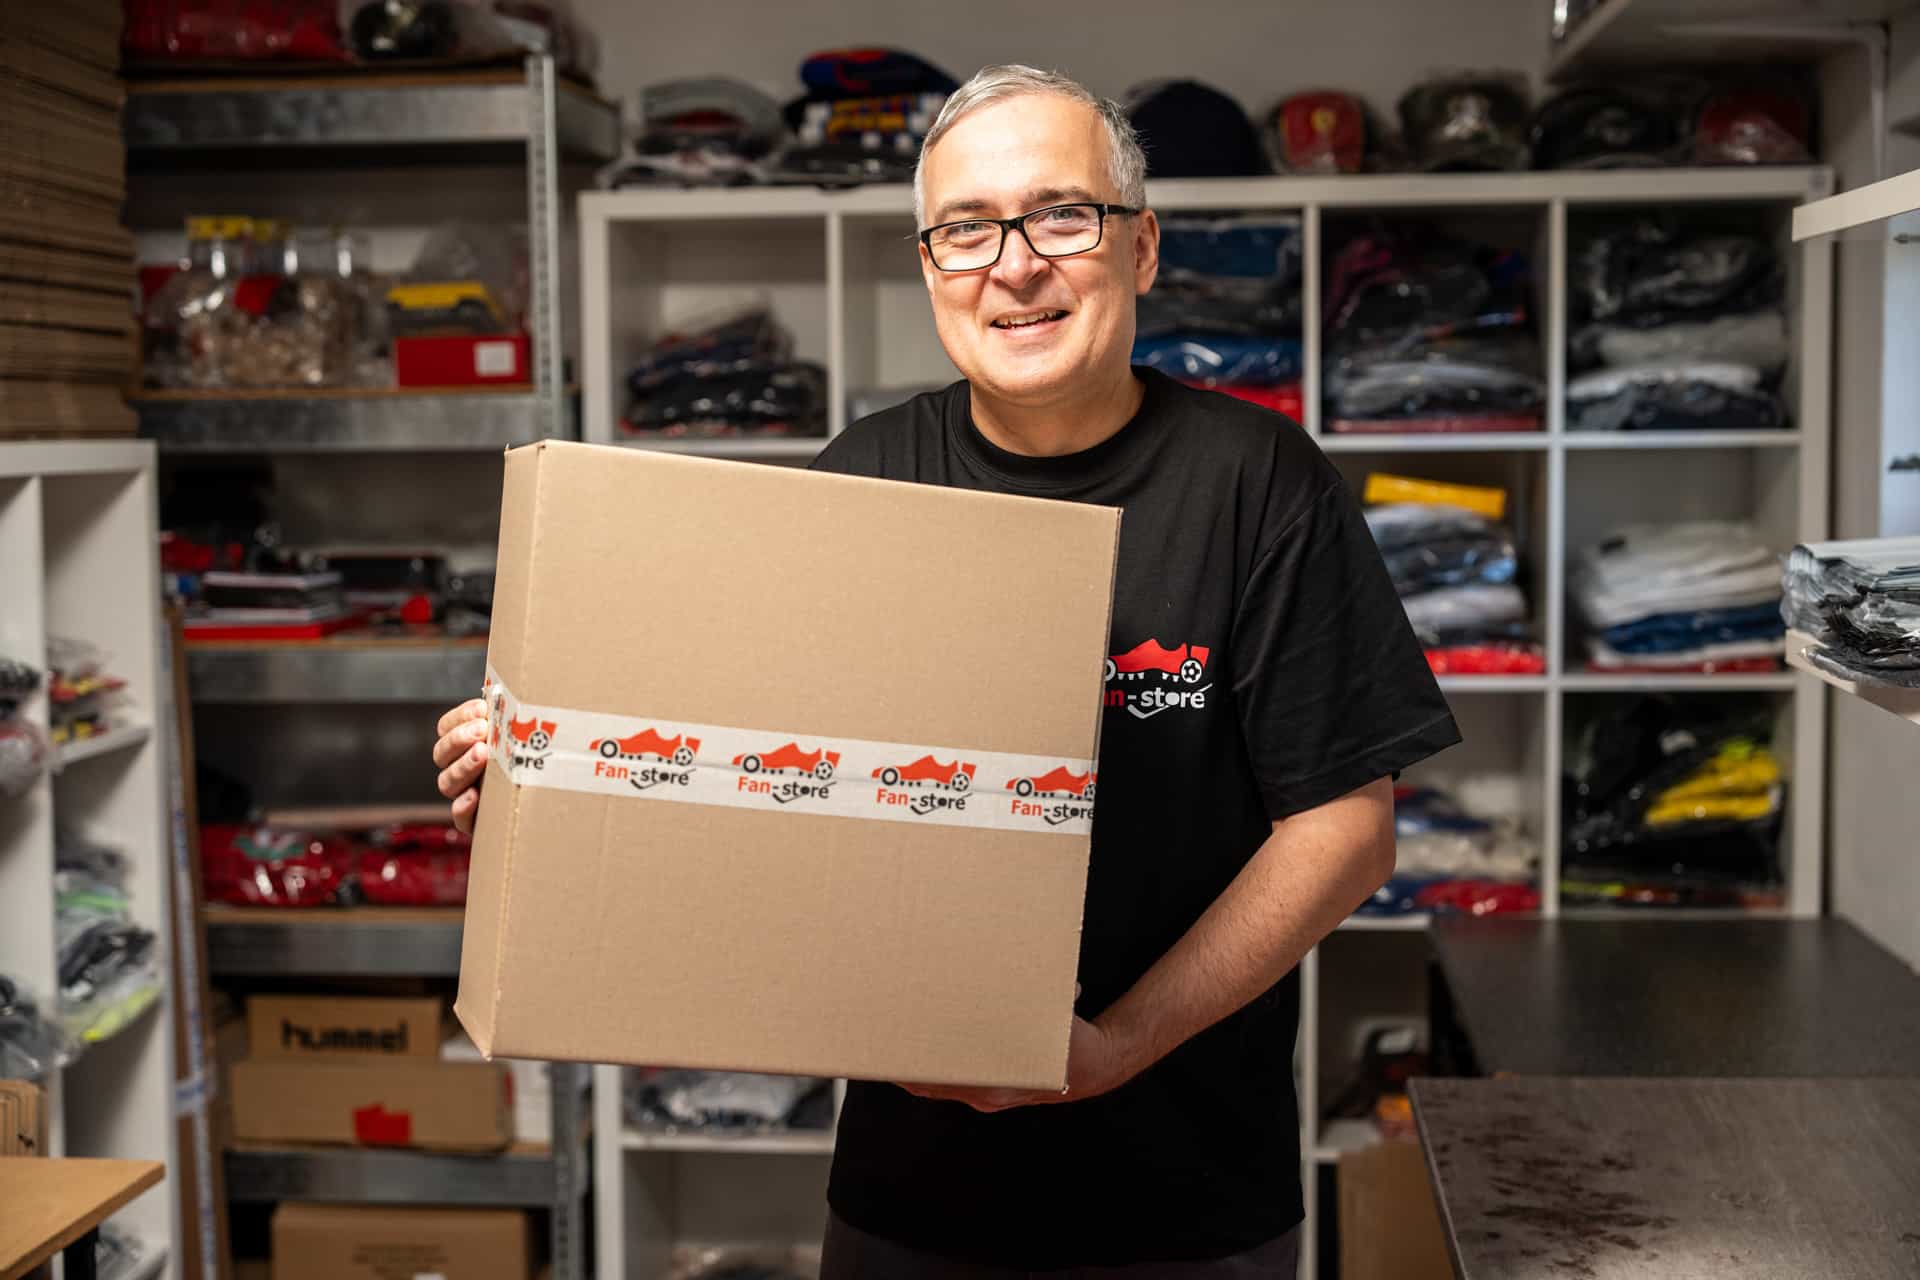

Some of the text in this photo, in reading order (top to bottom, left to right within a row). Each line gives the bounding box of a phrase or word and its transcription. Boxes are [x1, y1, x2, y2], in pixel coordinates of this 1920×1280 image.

[1103, 687, 1206, 709] n-store
[594, 761, 689, 786] Fan-store
[737, 776, 829, 799] Fan-store
[876, 788, 966, 810] Fan-store
